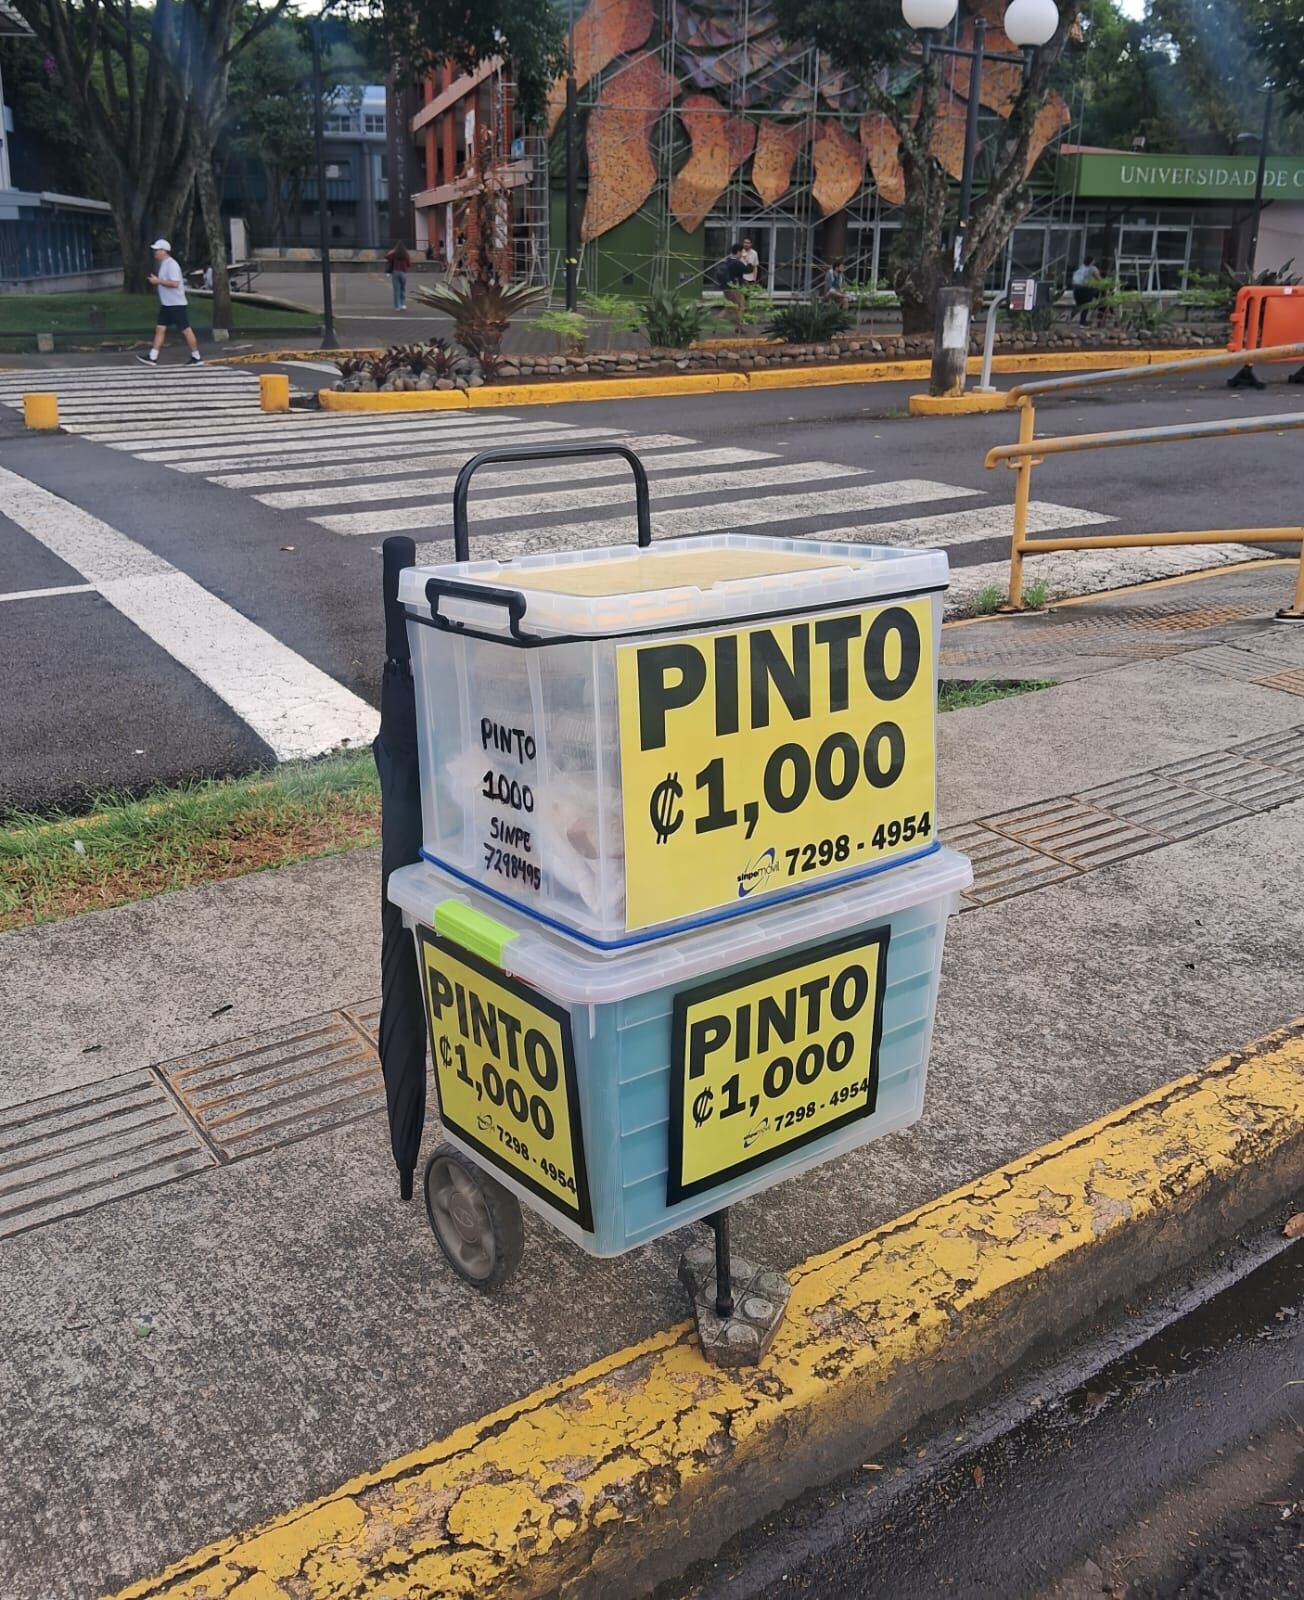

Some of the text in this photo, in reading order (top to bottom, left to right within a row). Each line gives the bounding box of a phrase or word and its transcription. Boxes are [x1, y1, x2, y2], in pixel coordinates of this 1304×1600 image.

[1120, 165, 1257, 187] UNIVERSIDAD
[1262, 169, 1288, 187] DE
[637, 606, 921, 752] PINTO
[480, 717, 537, 765] PINTO
[482, 769, 534, 813] 1000
[490, 816, 531, 853] SINPE
[785, 834, 850, 877] 7298
[871, 811, 931, 851] 4954
[483, 842, 542, 890] 7298495
[428, 965, 559, 1092] PINTO
[689, 963, 869, 1080] PINTO
[774, 1101, 816, 1132] 7298
[829, 1077, 869, 1107] 4954
[496, 1124, 530, 1161] 7298
[540, 1157, 577, 1195] 4954
